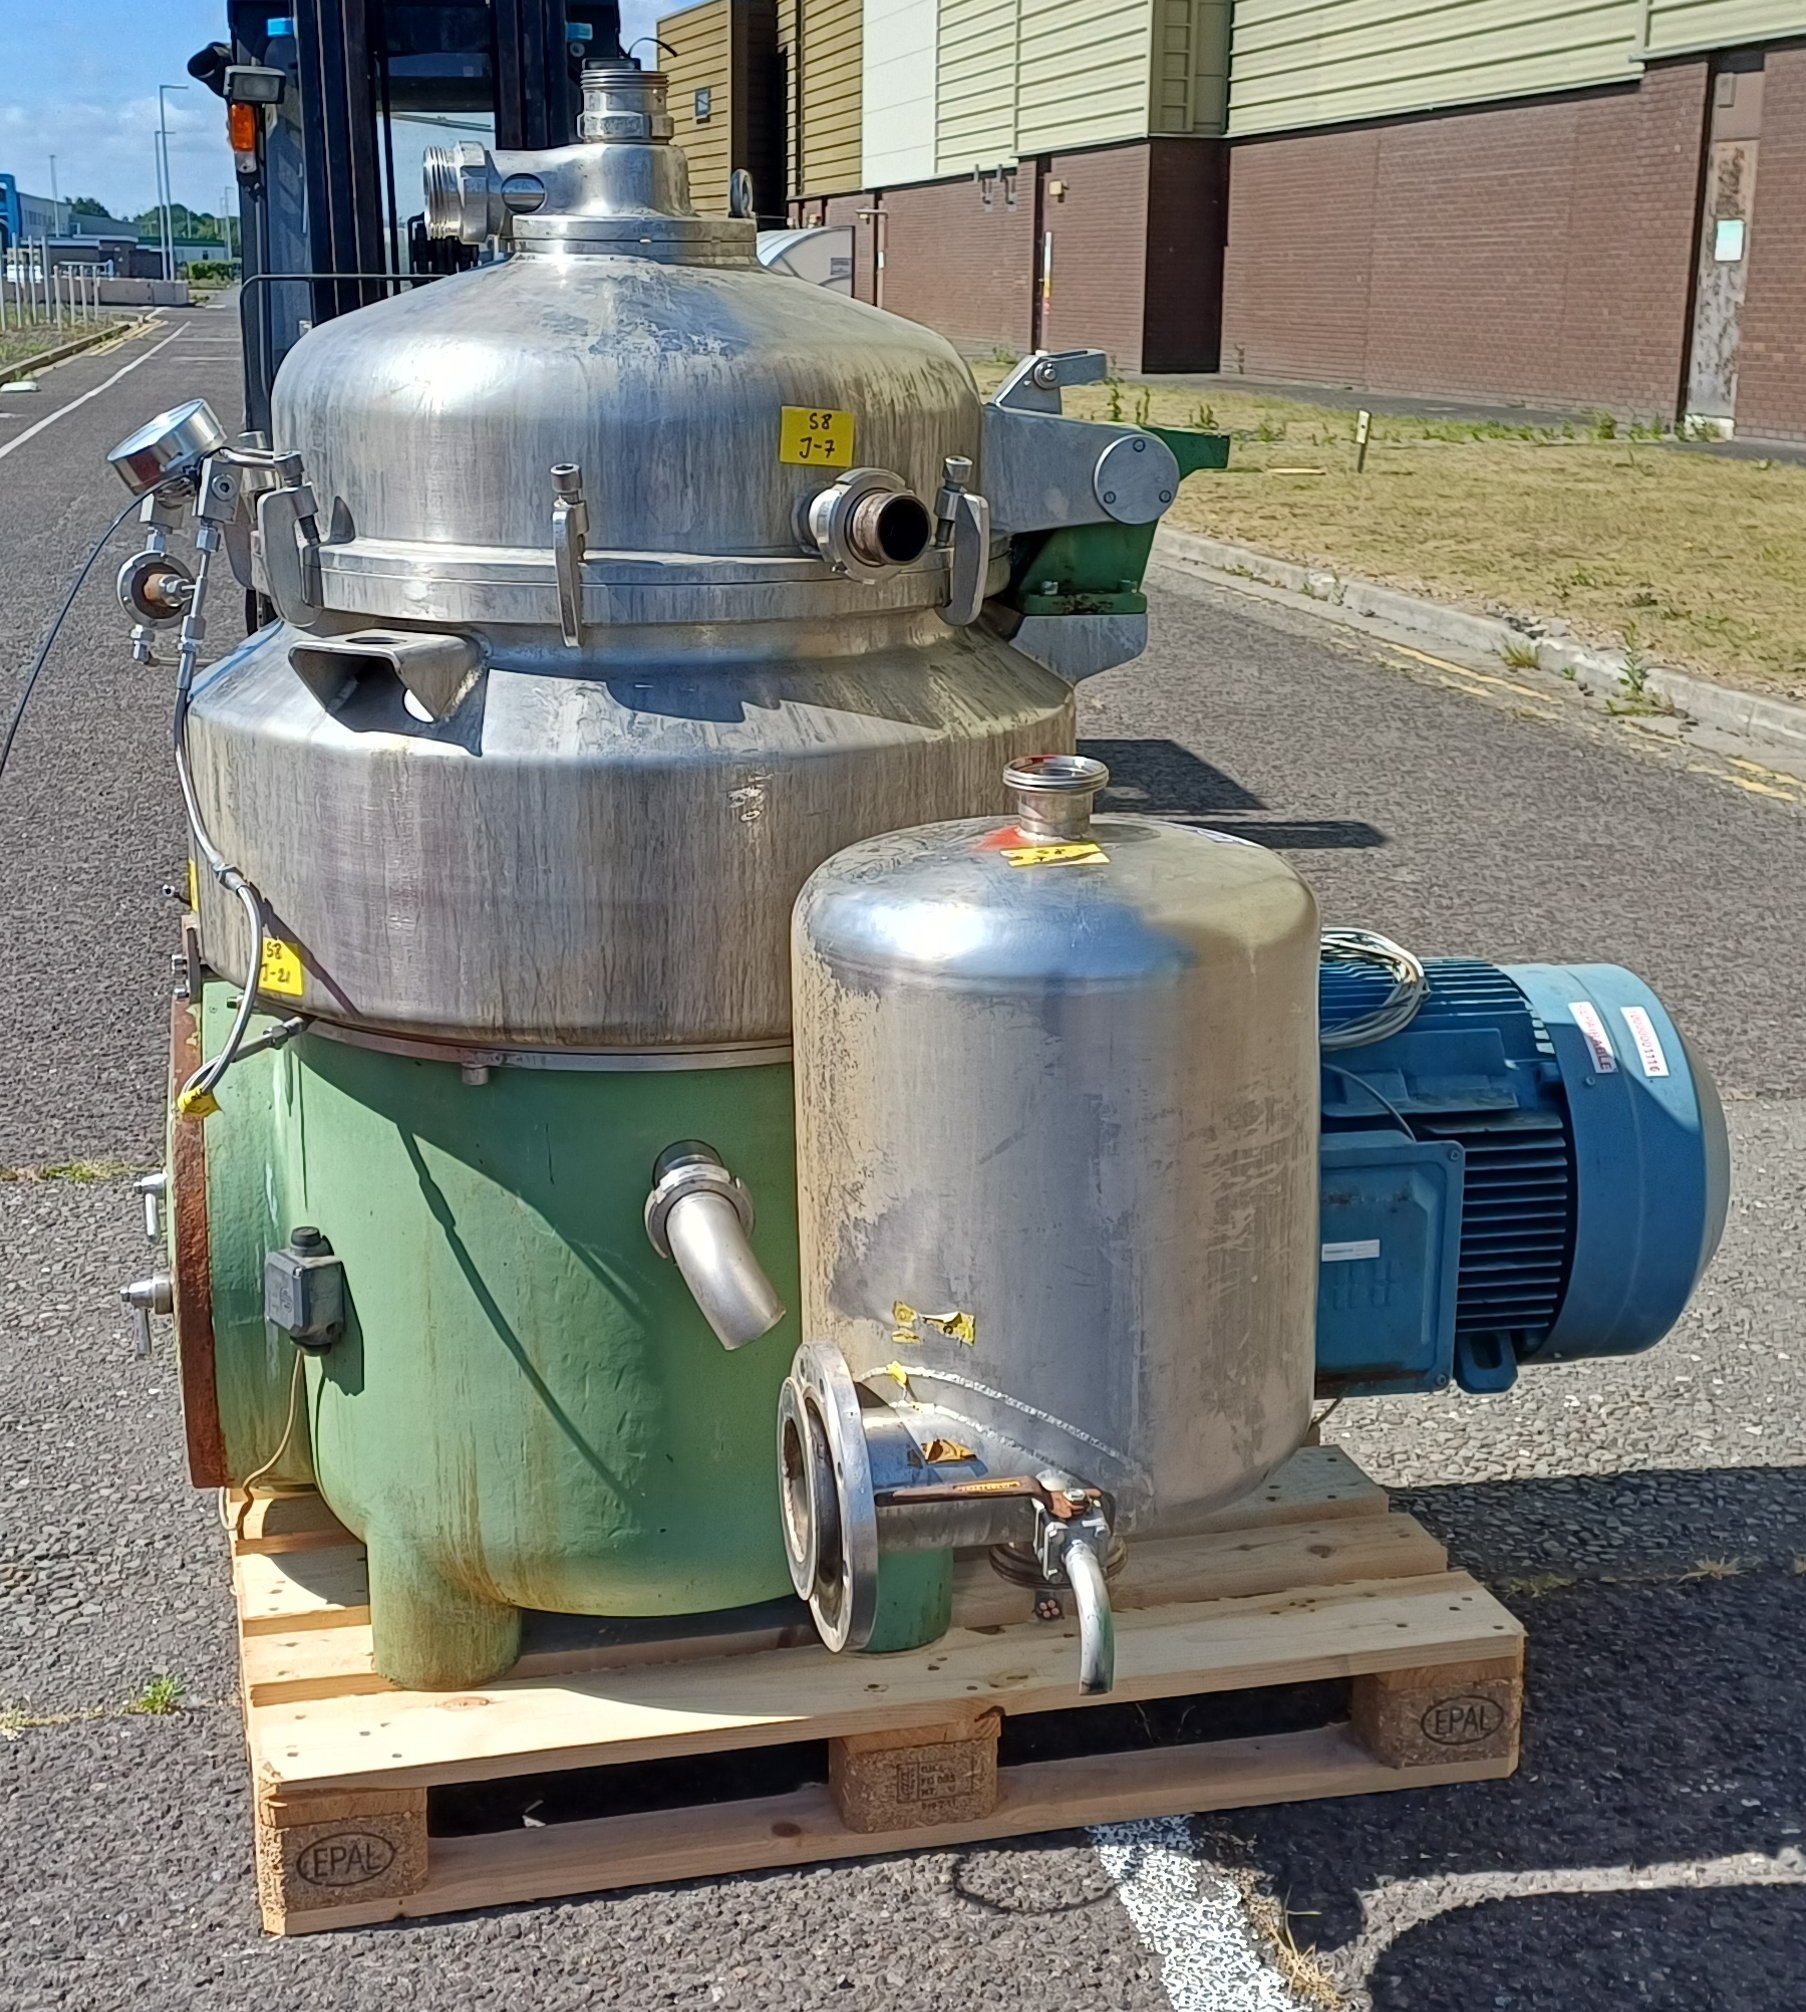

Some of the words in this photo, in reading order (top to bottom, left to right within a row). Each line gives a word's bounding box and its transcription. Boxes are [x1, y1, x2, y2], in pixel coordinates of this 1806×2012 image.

[809, 412, 832, 430] S8
[799, 436, 836, 459] J-7
[1434, 1704, 1492, 1736] EPAL
[313, 1842, 383, 1878] EPAL
